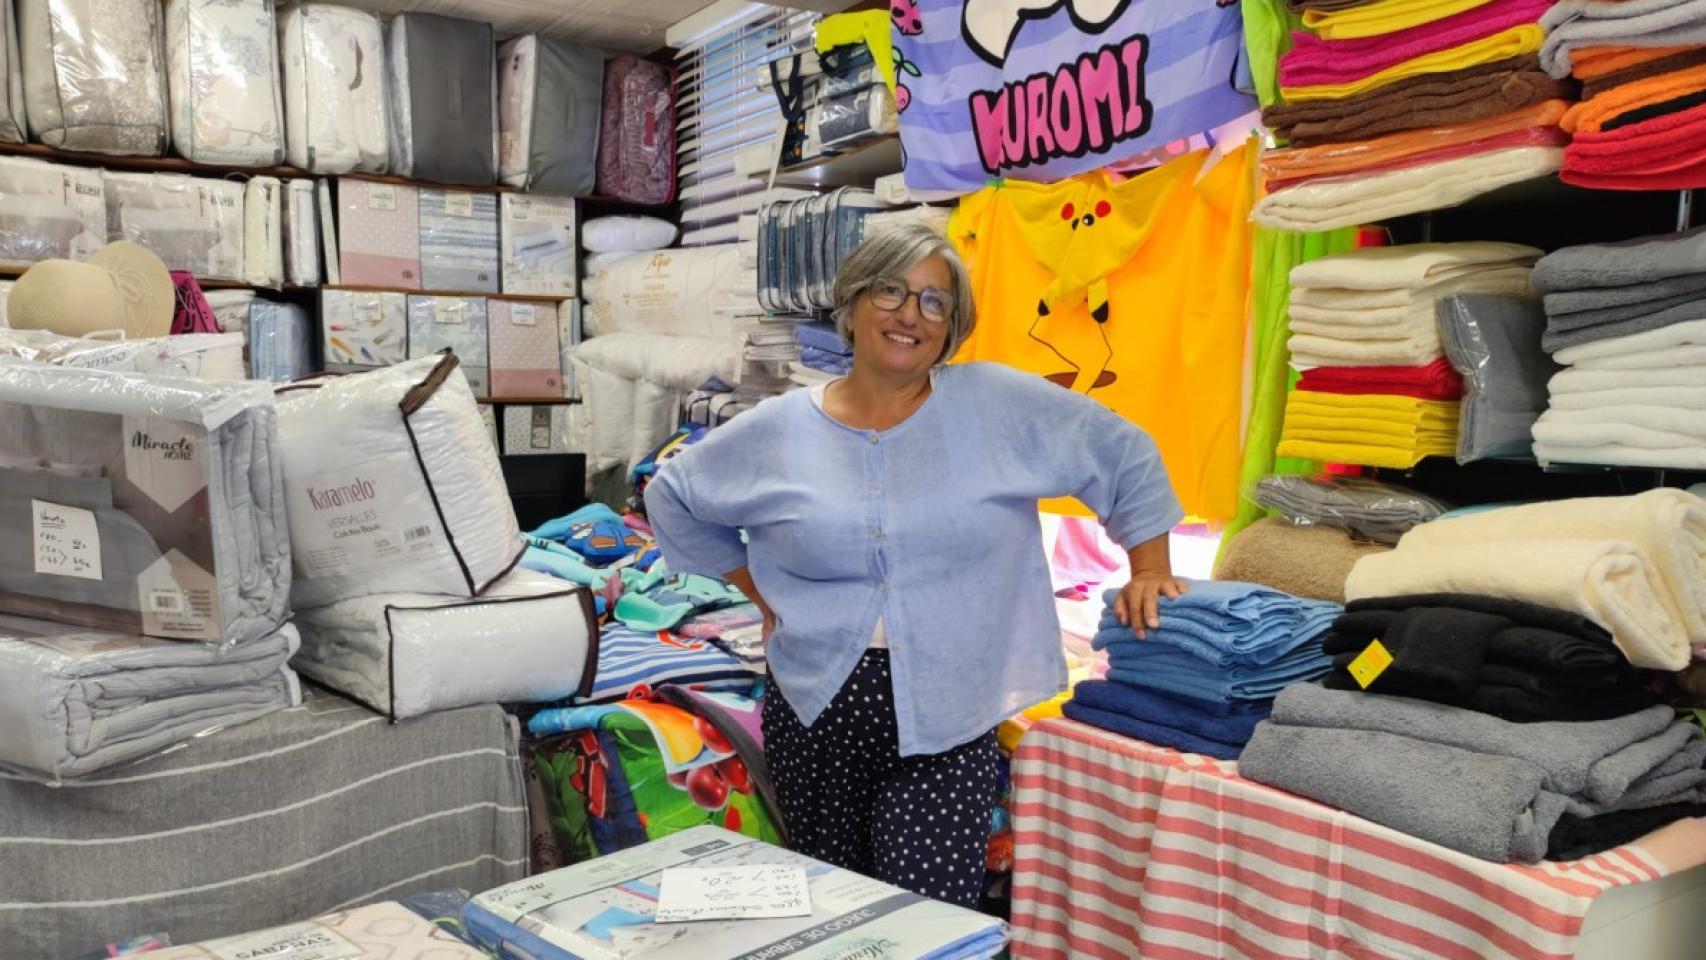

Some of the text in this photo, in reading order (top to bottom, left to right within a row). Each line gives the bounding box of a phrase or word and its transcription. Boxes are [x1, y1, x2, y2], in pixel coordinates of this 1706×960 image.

[969, 33, 1153, 176] KUROMI
[131, 430, 193, 452] Miracle
[306, 477, 376, 511] Karamelo
[824, 909, 876, 932] JUEGO
[800, 929, 827, 941] DE
